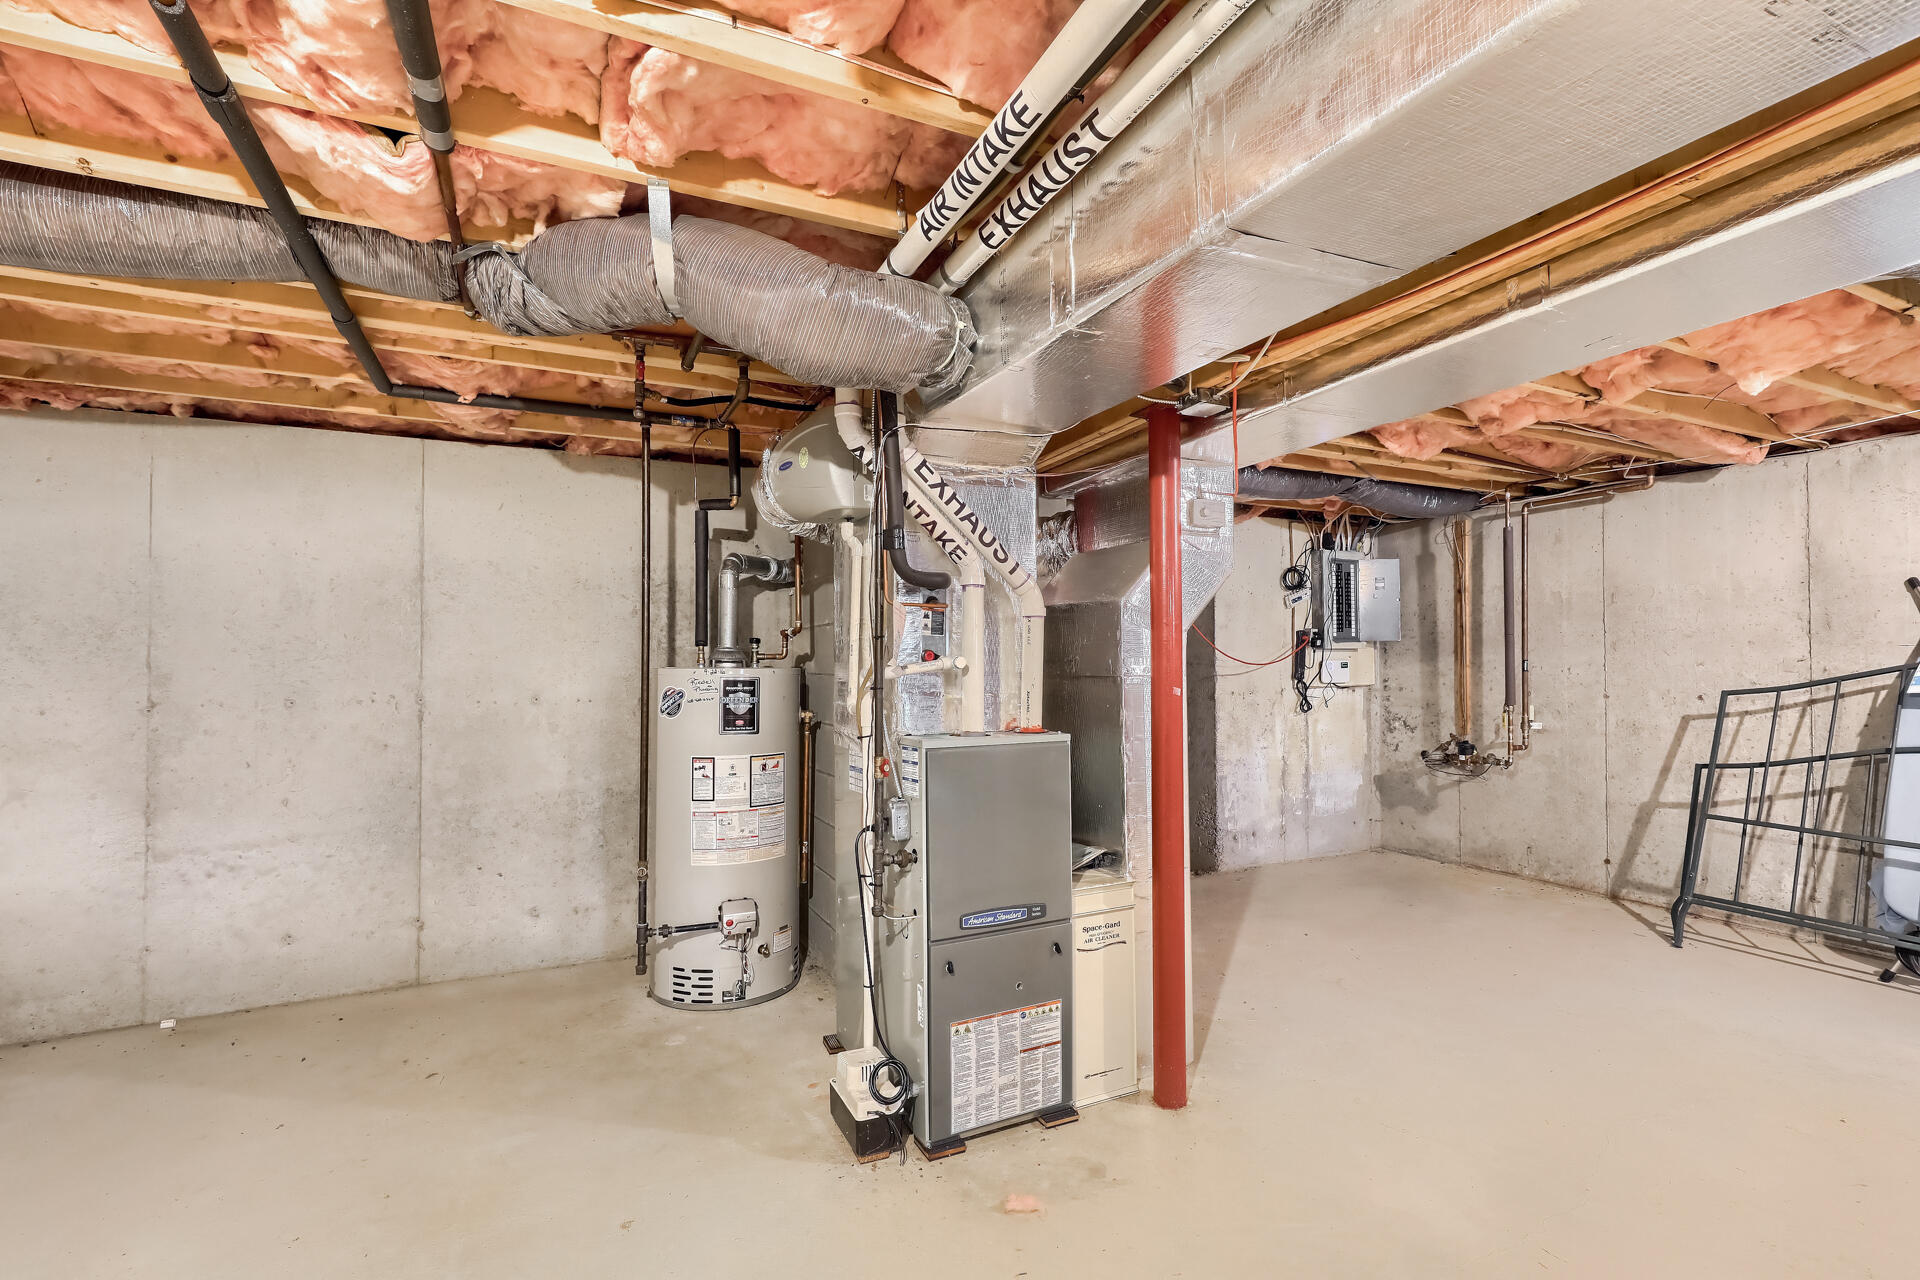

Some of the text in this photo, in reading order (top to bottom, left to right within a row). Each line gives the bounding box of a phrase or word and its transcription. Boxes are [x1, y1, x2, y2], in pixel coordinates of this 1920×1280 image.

[920, 187, 960, 242] AIR
[950, 89, 1043, 201] INTAKE
[978, 107, 1114, 250] EXHAUST
[902, 490, 968, 565] NTAKE
[720, 696, 759, 704] DEFENDER
[967, 910, 1023, 926] American Standard
[1095, 933, 1121, 942] CLEANER
